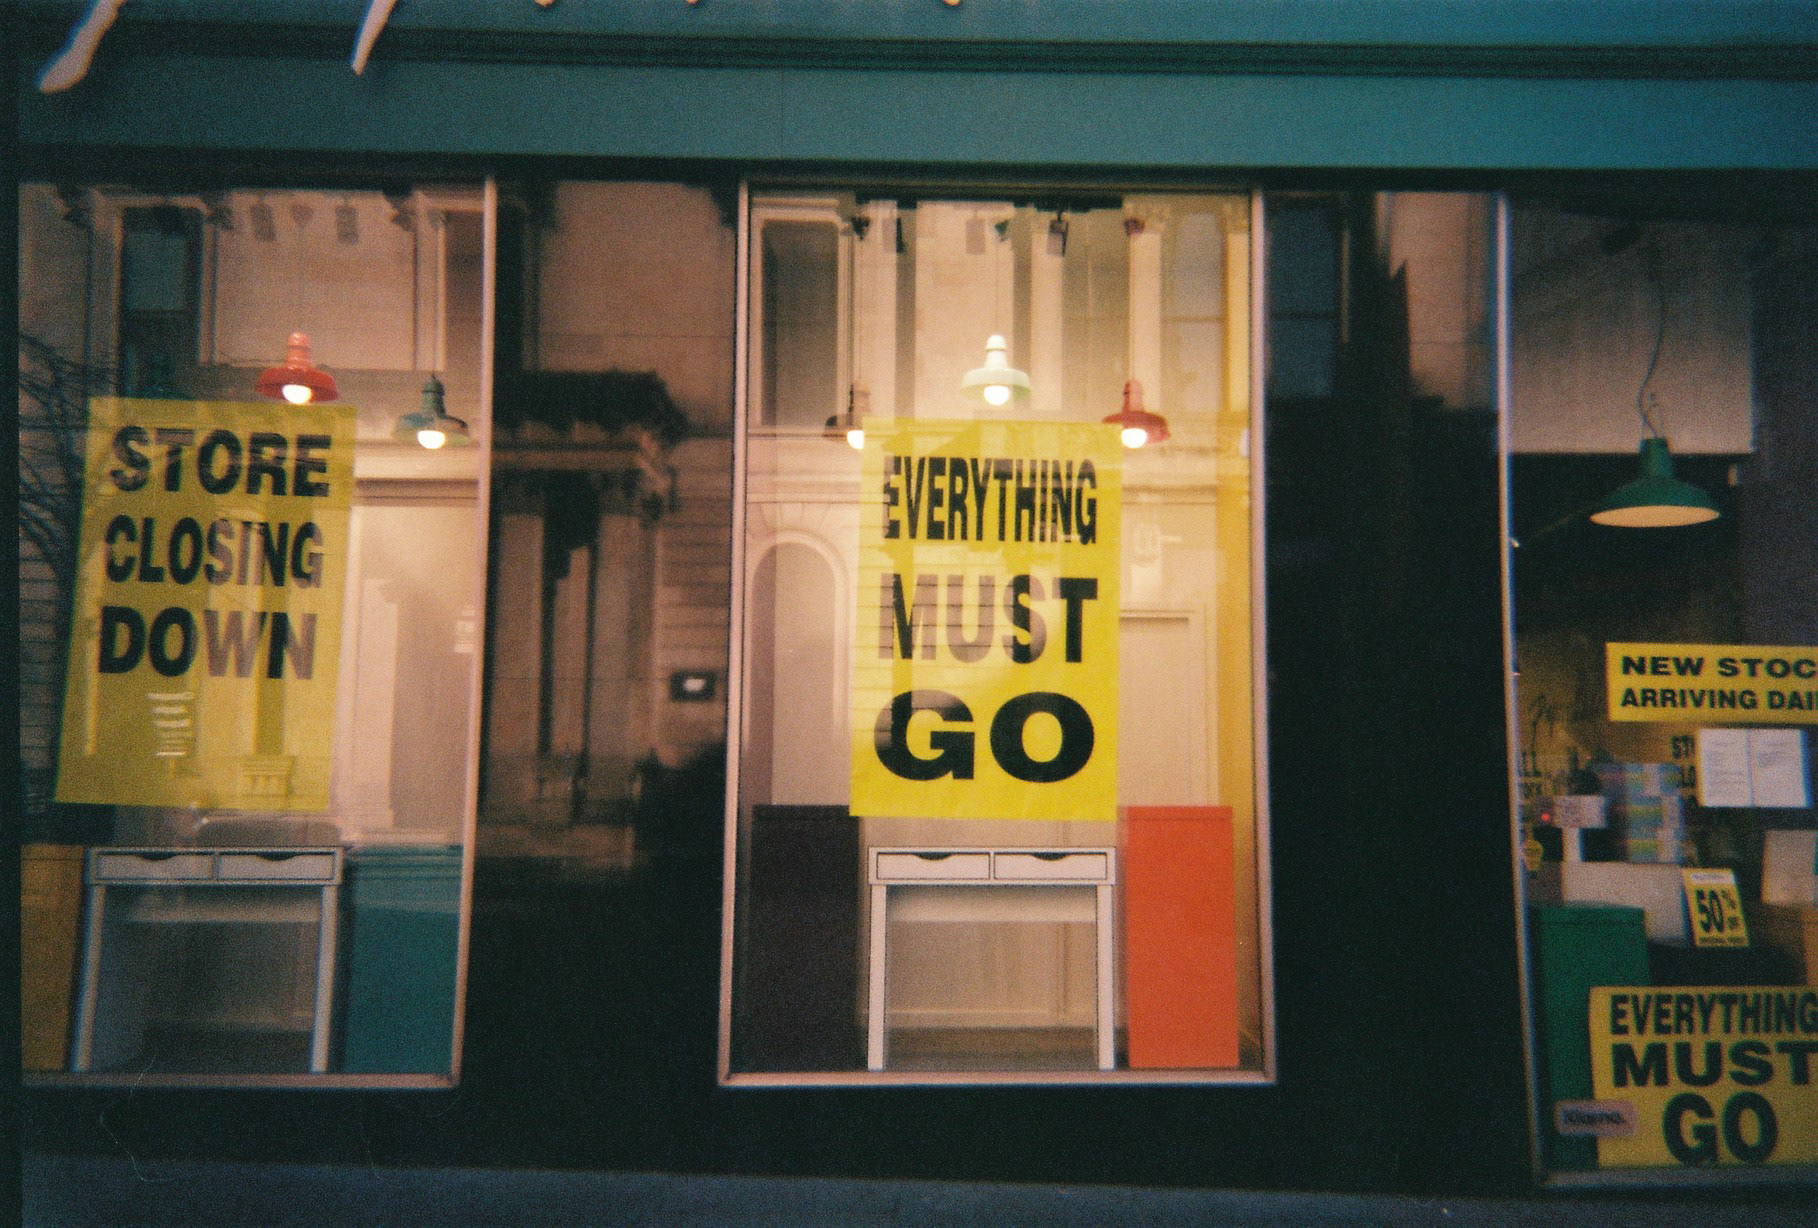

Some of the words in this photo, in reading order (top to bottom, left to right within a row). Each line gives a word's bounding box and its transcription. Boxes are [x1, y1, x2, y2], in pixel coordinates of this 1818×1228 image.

[110, 426, 332, 497] STORE
[883, 456, 1097, 545] EVERYTHING
[105, 515, 324, 588] CLOSING
[98, 606, 317, 680] DOWN
[878, 573, 1098, 664] MUST
[1620, 687, 1757, 709] ARRIVING
[1621, 656, 1704, 676] NEW
[874, 689, 1095, 783] GO
[1610, 993, 1818, 1035] EVERYTHING
[1612, 1041, 1818, 1086] MUST
[1662, 1093, 1778, 1164] GO
